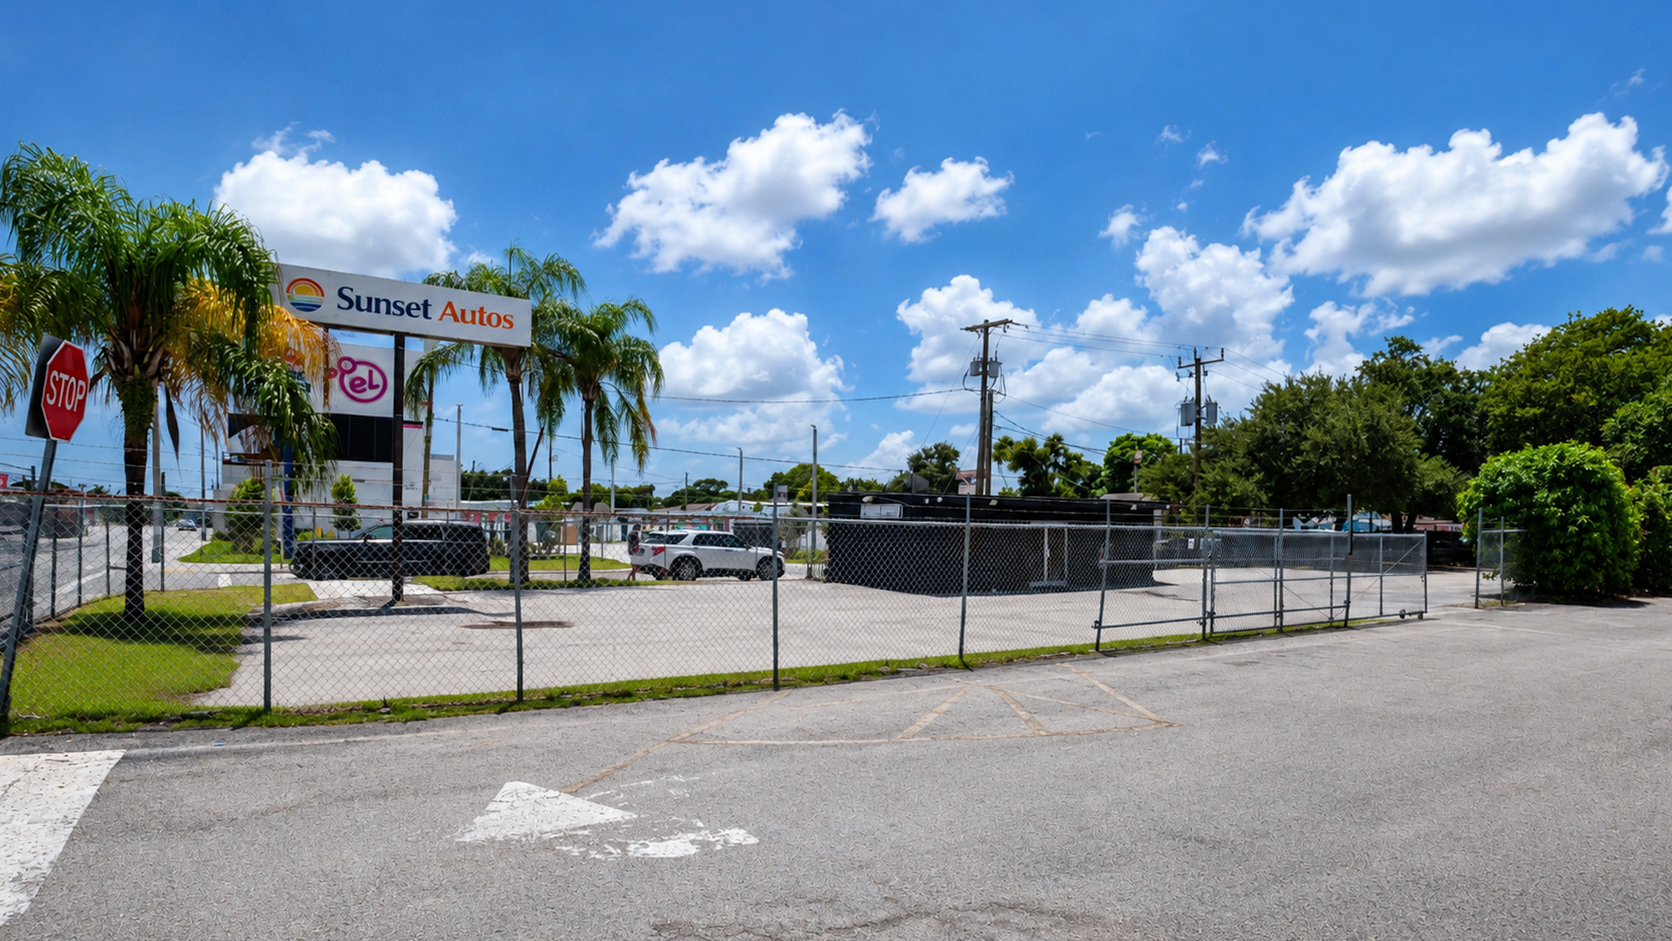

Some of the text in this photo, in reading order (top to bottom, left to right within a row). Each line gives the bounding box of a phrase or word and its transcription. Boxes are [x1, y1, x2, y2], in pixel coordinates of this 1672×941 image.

[337, 286, 514, 330] Sunset Autos
[47, 370, 86, 412] STOP
